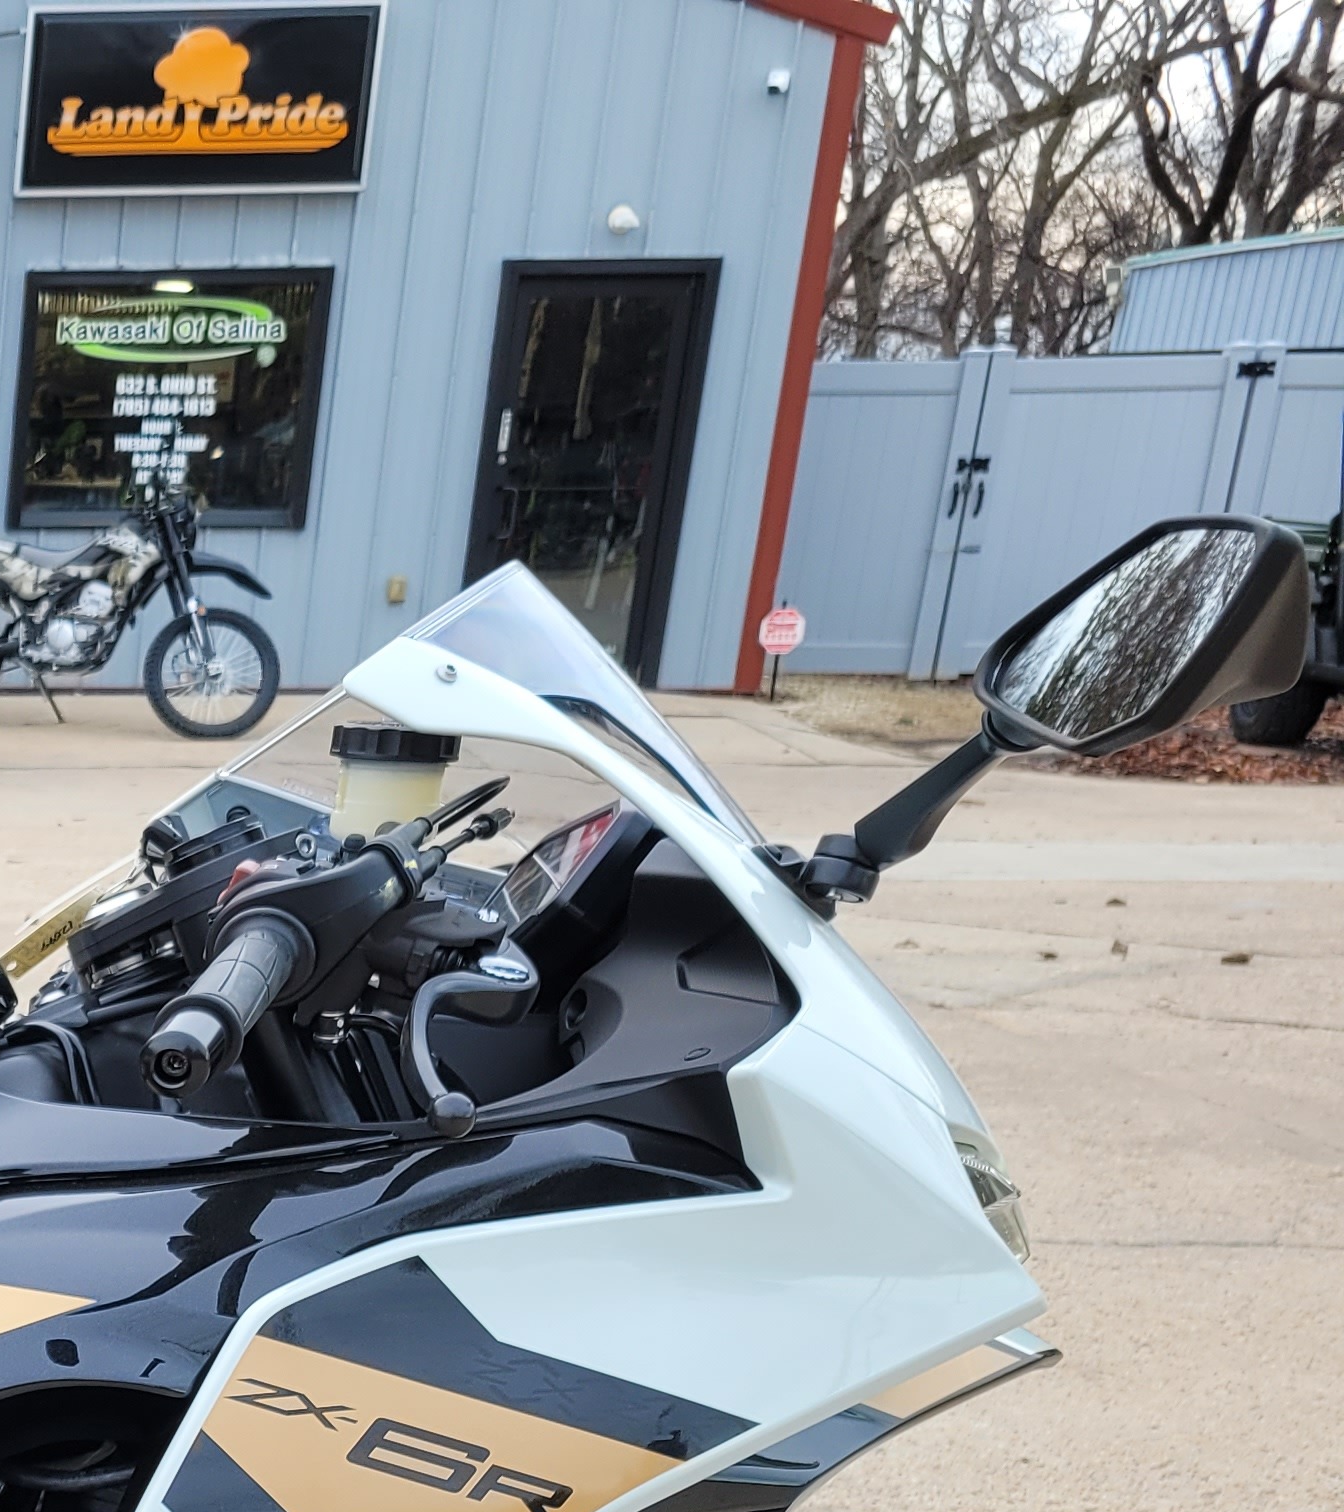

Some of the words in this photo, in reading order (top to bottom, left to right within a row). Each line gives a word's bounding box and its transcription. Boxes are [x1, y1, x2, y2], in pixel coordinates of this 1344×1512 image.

[56, 96, 179, 138] Land
[213, 93, 346, 136] Pride
[56, 316, 169, 344] Kawasaki
[174, 316, 205, 342] Of
[208, 315, 287, 343] Salina
